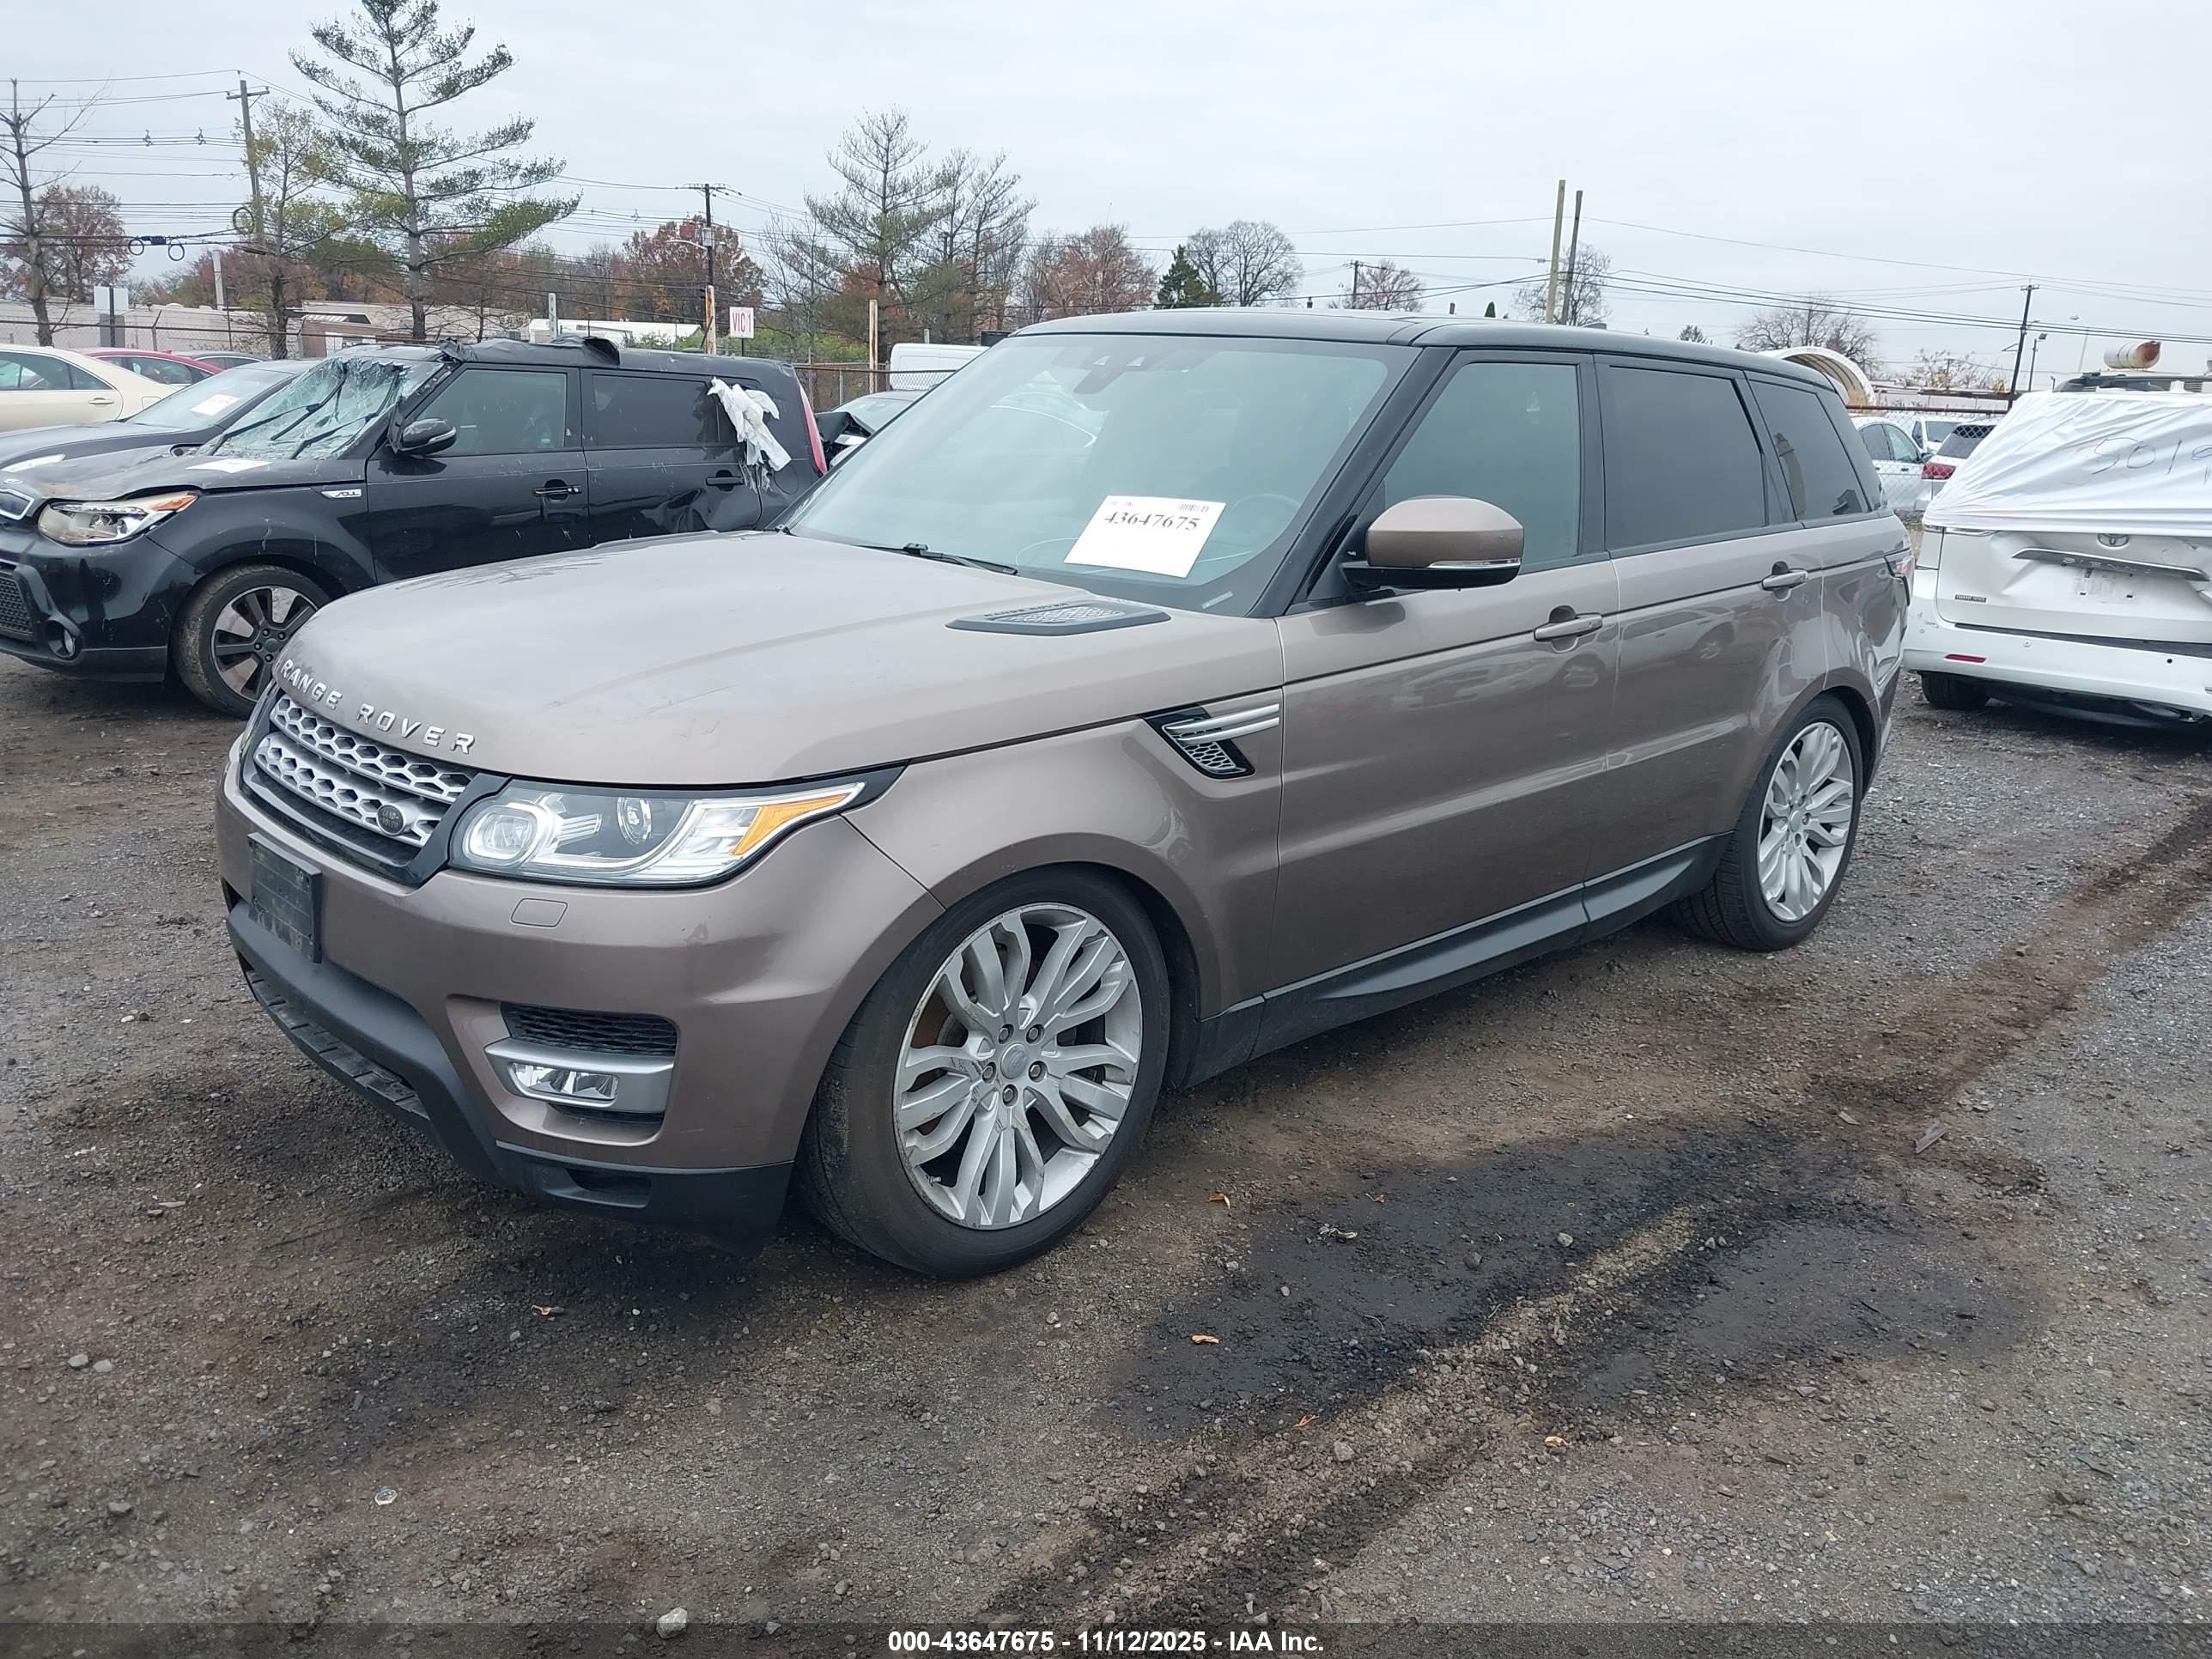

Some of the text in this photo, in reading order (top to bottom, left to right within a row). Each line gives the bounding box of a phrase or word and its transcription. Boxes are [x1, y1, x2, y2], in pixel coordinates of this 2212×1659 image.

[732, 312, 752, 333] VIC 1
[1104, 511, 1201, 531] 43647675
[2062, 556, 2152, 574] SIEN
[280, 659, 477, 756] RANGE ROVER
